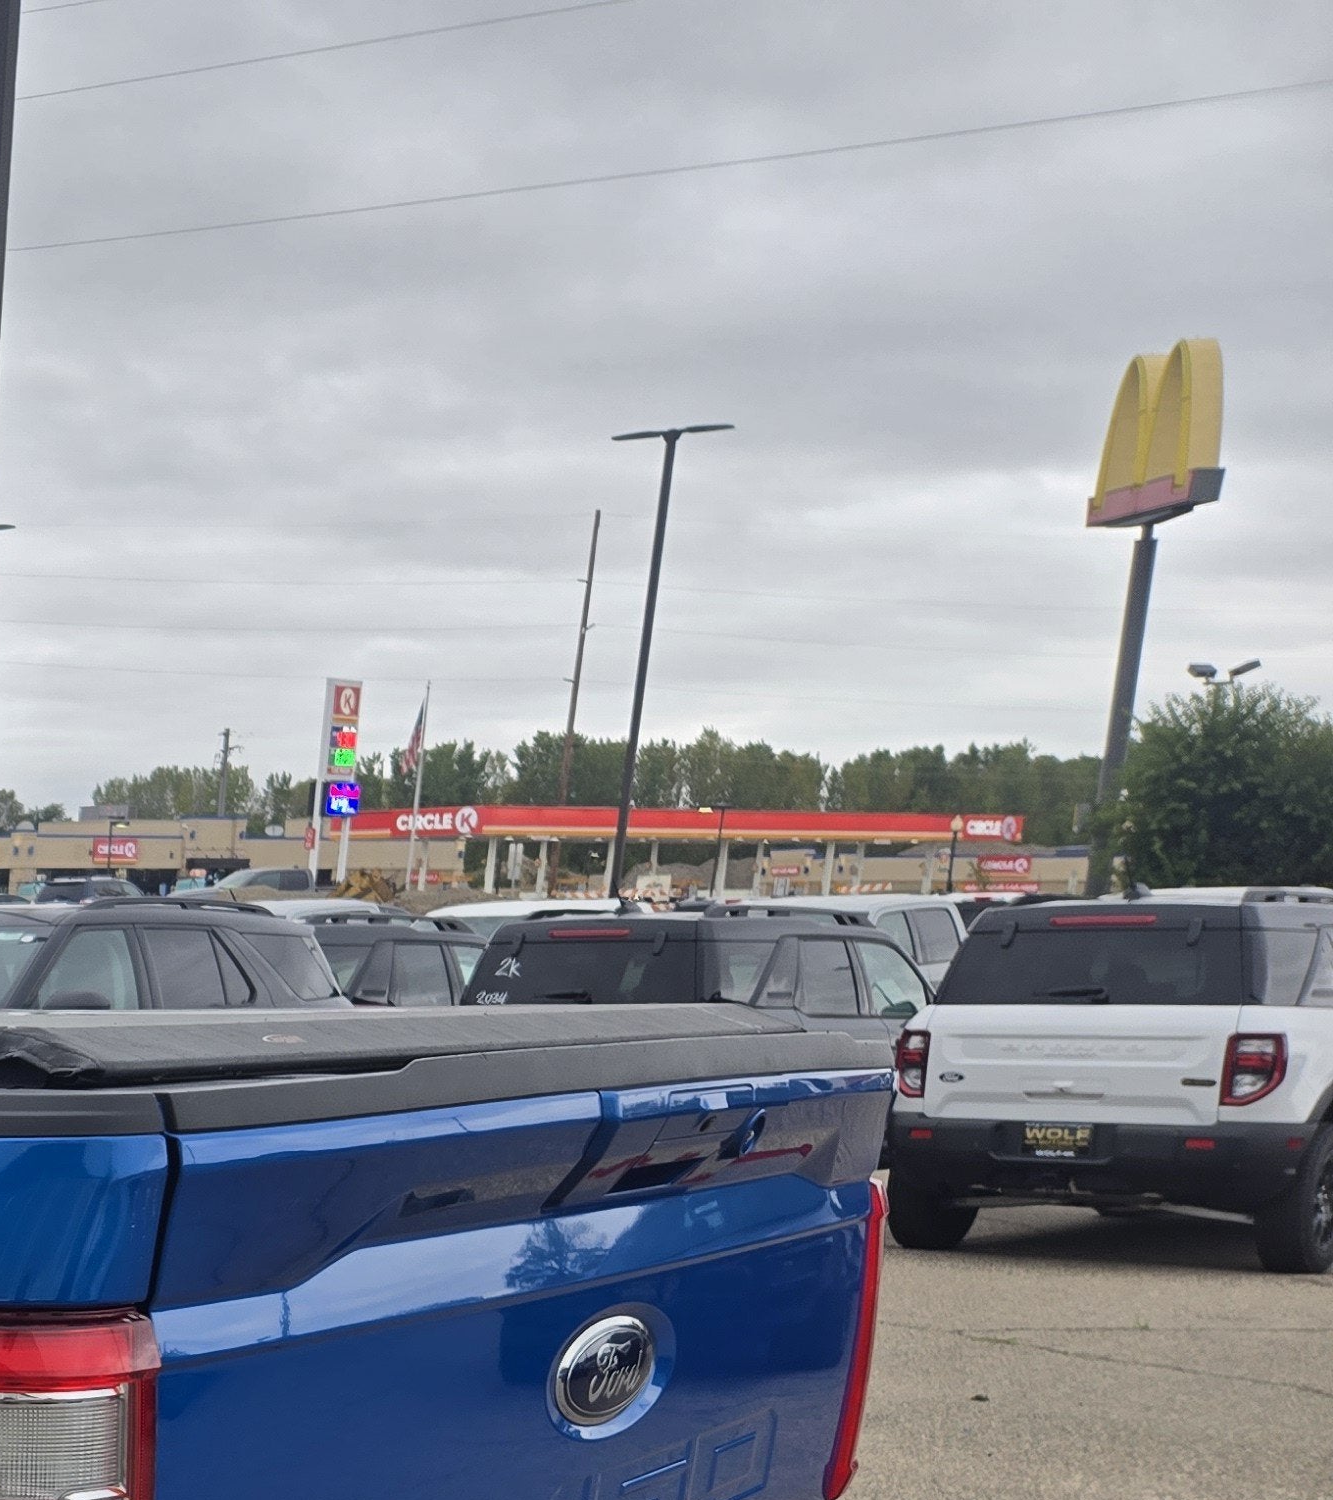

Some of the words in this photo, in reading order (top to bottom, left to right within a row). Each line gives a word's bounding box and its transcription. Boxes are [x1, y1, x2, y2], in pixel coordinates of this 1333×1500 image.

[341, 689, 356, 715] K
[396, 812, 453, 831] CIRCLE
[457, 808, 477, 834] K
[495, 956, 521, 978] 2K
[476, 990, 508, 1005] 2034
[1025, 1127, 1091, 1140] WOLF
[588, 1341, 643, 1403] Ford
